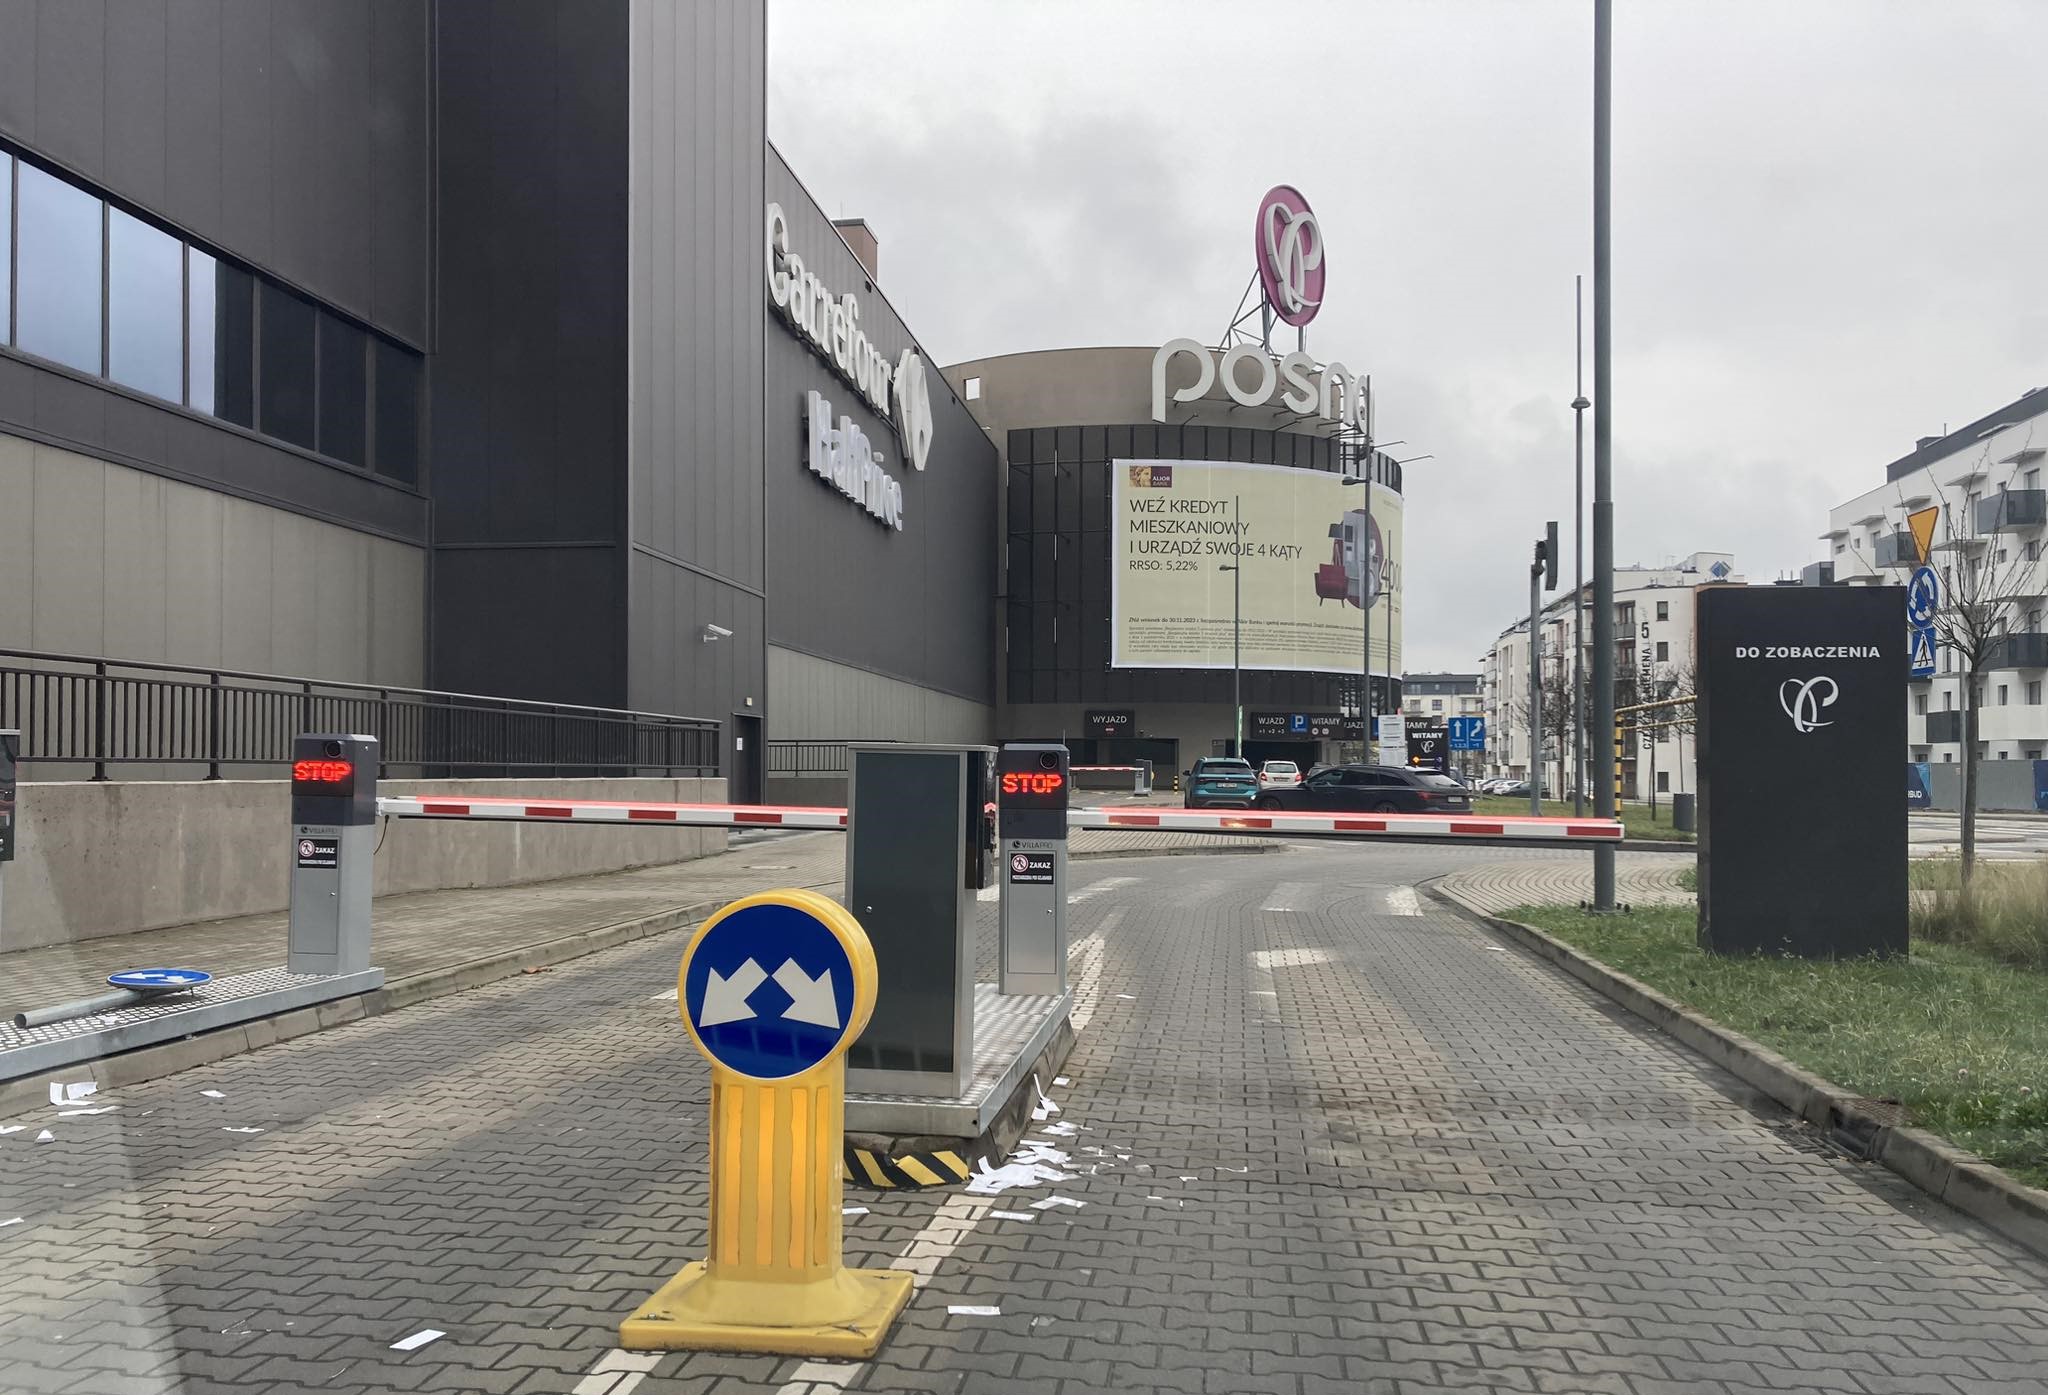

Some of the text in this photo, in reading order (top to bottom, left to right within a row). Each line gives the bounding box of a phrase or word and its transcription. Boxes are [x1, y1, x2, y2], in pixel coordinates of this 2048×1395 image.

[766, 202, 890, 415] Carrefour
[1129, 496, 1228, 514] WEŹ KREDYT
[1130, 520, 1250, 535] MIESZKANIOWY
[1138, 538, 1202, 557] URZĄDŹ
[1205, 541, 1254, 556] SWOJE
[1257, 544, 1266, 557] 4
[1269, 545, 1302, 561] KĄTY
[1129, 560, 1198, 571] RRSO: 5,22%
[1641, 622, 1649, 639] 5
[1735, 646, 1881, 658] DO ZOBACZENIA
[1092, 715, 1128, 724] WYJAZD
[1258, 717, 1285, 725] WJAZD
[1311, 717, 1341, 725] WITAMY
[293, 760, 352, 781] STOP
[1002, 773, 1062, 793] STOP
[1029, 861, 1051, 869] ZAKAZ
